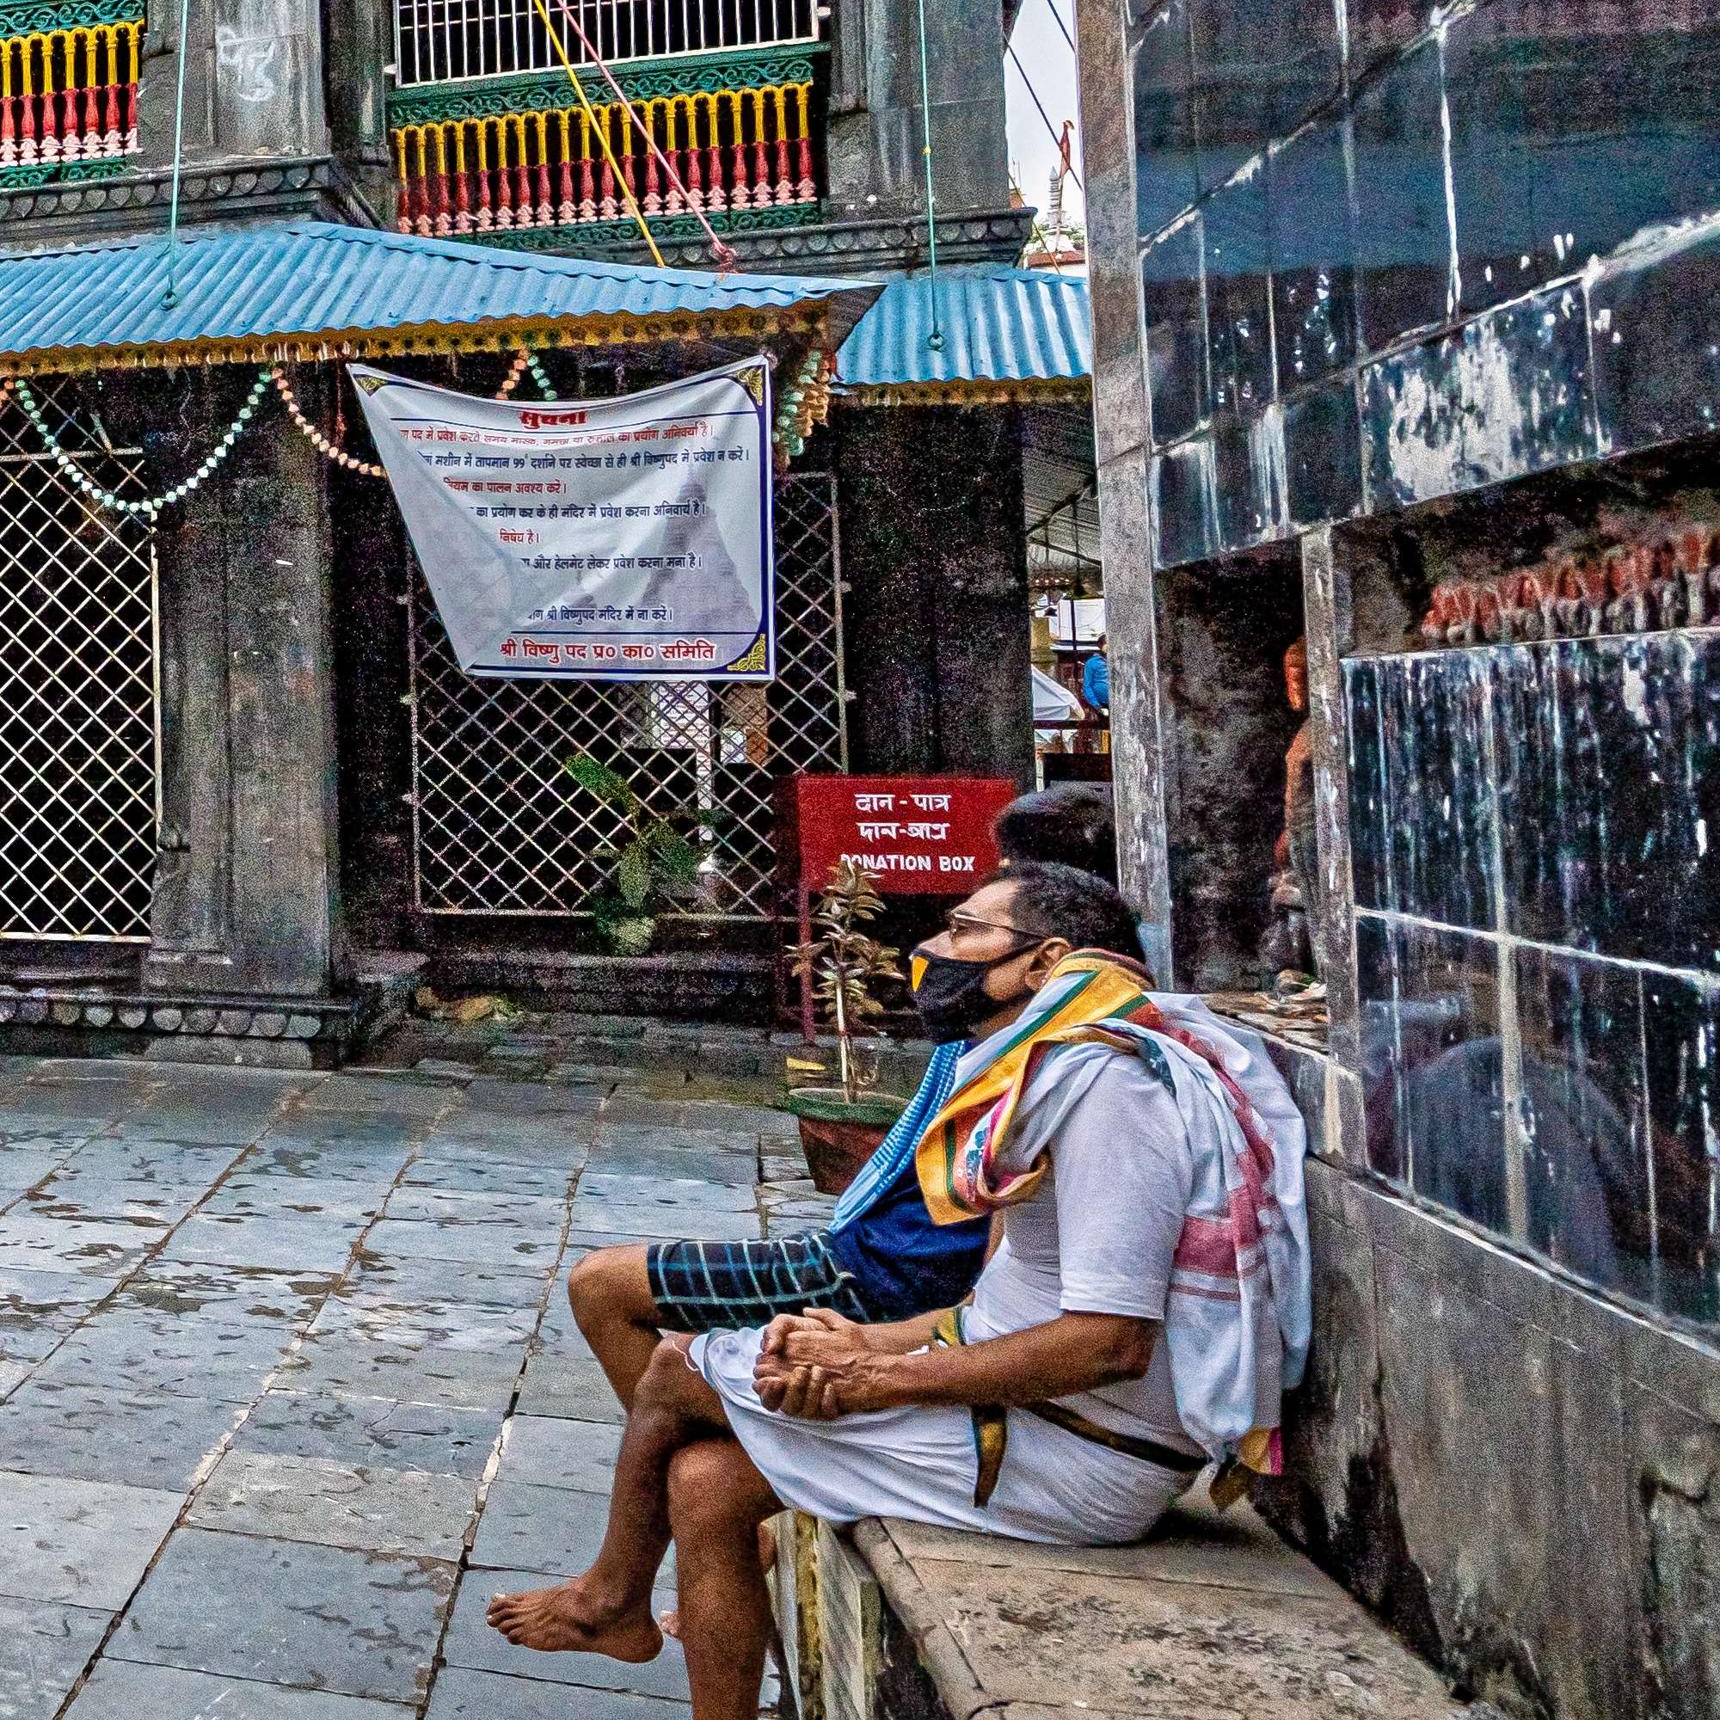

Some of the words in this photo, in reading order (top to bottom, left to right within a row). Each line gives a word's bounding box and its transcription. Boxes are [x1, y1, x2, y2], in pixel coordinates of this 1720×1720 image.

[437, 427, 457, 441] प्रवेश
[617, 432, 630, 443] का
[633, 426, 660, 441] प्रयोग
[436, 450, 461, 467] मशीन
[464, 451, 473, 467] में
[475, 456, 510, 469] तापमान
[559, 457, 572, 469] पर
[604, 452, 614, 468] से
[616, 451, 627, 469] ही
[630, 450, 641, 467] श्री
[693, 446, 715, 463] प्रवेश
[717, 449, 725, 462] न
[472, 481, 483, 493] का
[486, 481, 512, 494] पालन
[515, 481, 543, 495] अवश्य
[476, 506, 488, 519] का
[491, 502, 517, 519] प्रयोग
[518, 507, 533, 519] कर
[536, 503, 546, 519] के
[548, 503, 559, 520] ही
[560, 502, 586, 519] मंदिर
[599, 502, 622, 519] प्रवेश
[625, 505, 651, 518] करना
[533, 554, 552, 570] और
[554, 554, 585, 571] हेलमेट
[586, 553, 610, 570] लेकर
[613, 553, 635, 570] प्रवेश
[637, 557, 664, 570] करना
[666, 556, 686, 569] मना
[546, 605, 557, 622] श्री
[560, 605, 595, 626] विष्णुपद
[598, 606, 622, 622] मंदिर
[625, 605, 635, 621] में
[637, 608, 649, 621] ना
[500, 637, 517, 659] श्री
[522, 638, 560, 664] विष्णु
[565, 643, 587, 660] पद
[659, 639, 715, 660] समिति
[854, 793, 896, 814] दान
[909, 793, 953, 814] पात्र
[939, 855, 976, 872] BOX
